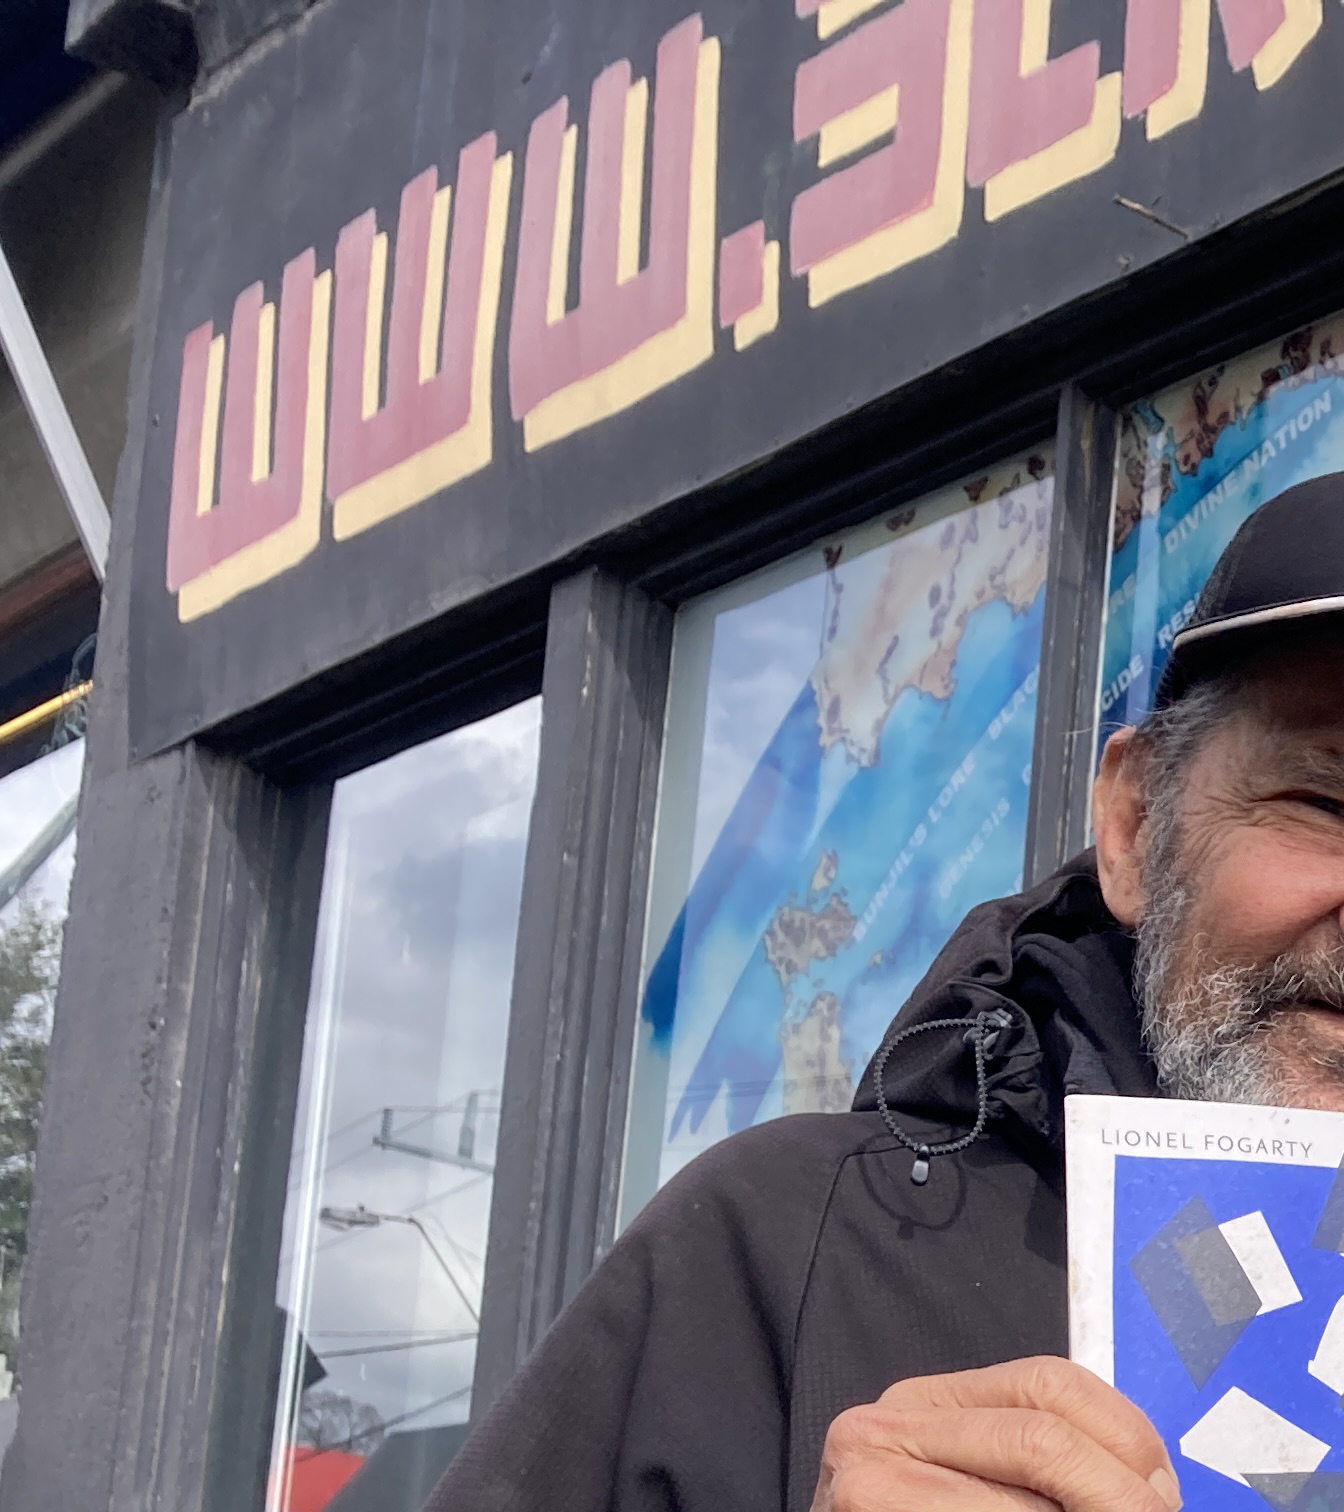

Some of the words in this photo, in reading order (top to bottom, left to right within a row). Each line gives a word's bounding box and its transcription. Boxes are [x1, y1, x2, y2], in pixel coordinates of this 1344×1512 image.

[1164, 471, 1238, 554] DIVINE
[1243, 389, 1332, 473] NATION
[1158, 592, 1200, 649] RES
[1101, 1128, 1193, 1149] LIONEL
[1204, 1134, 1313, 1158] FOGARTY
